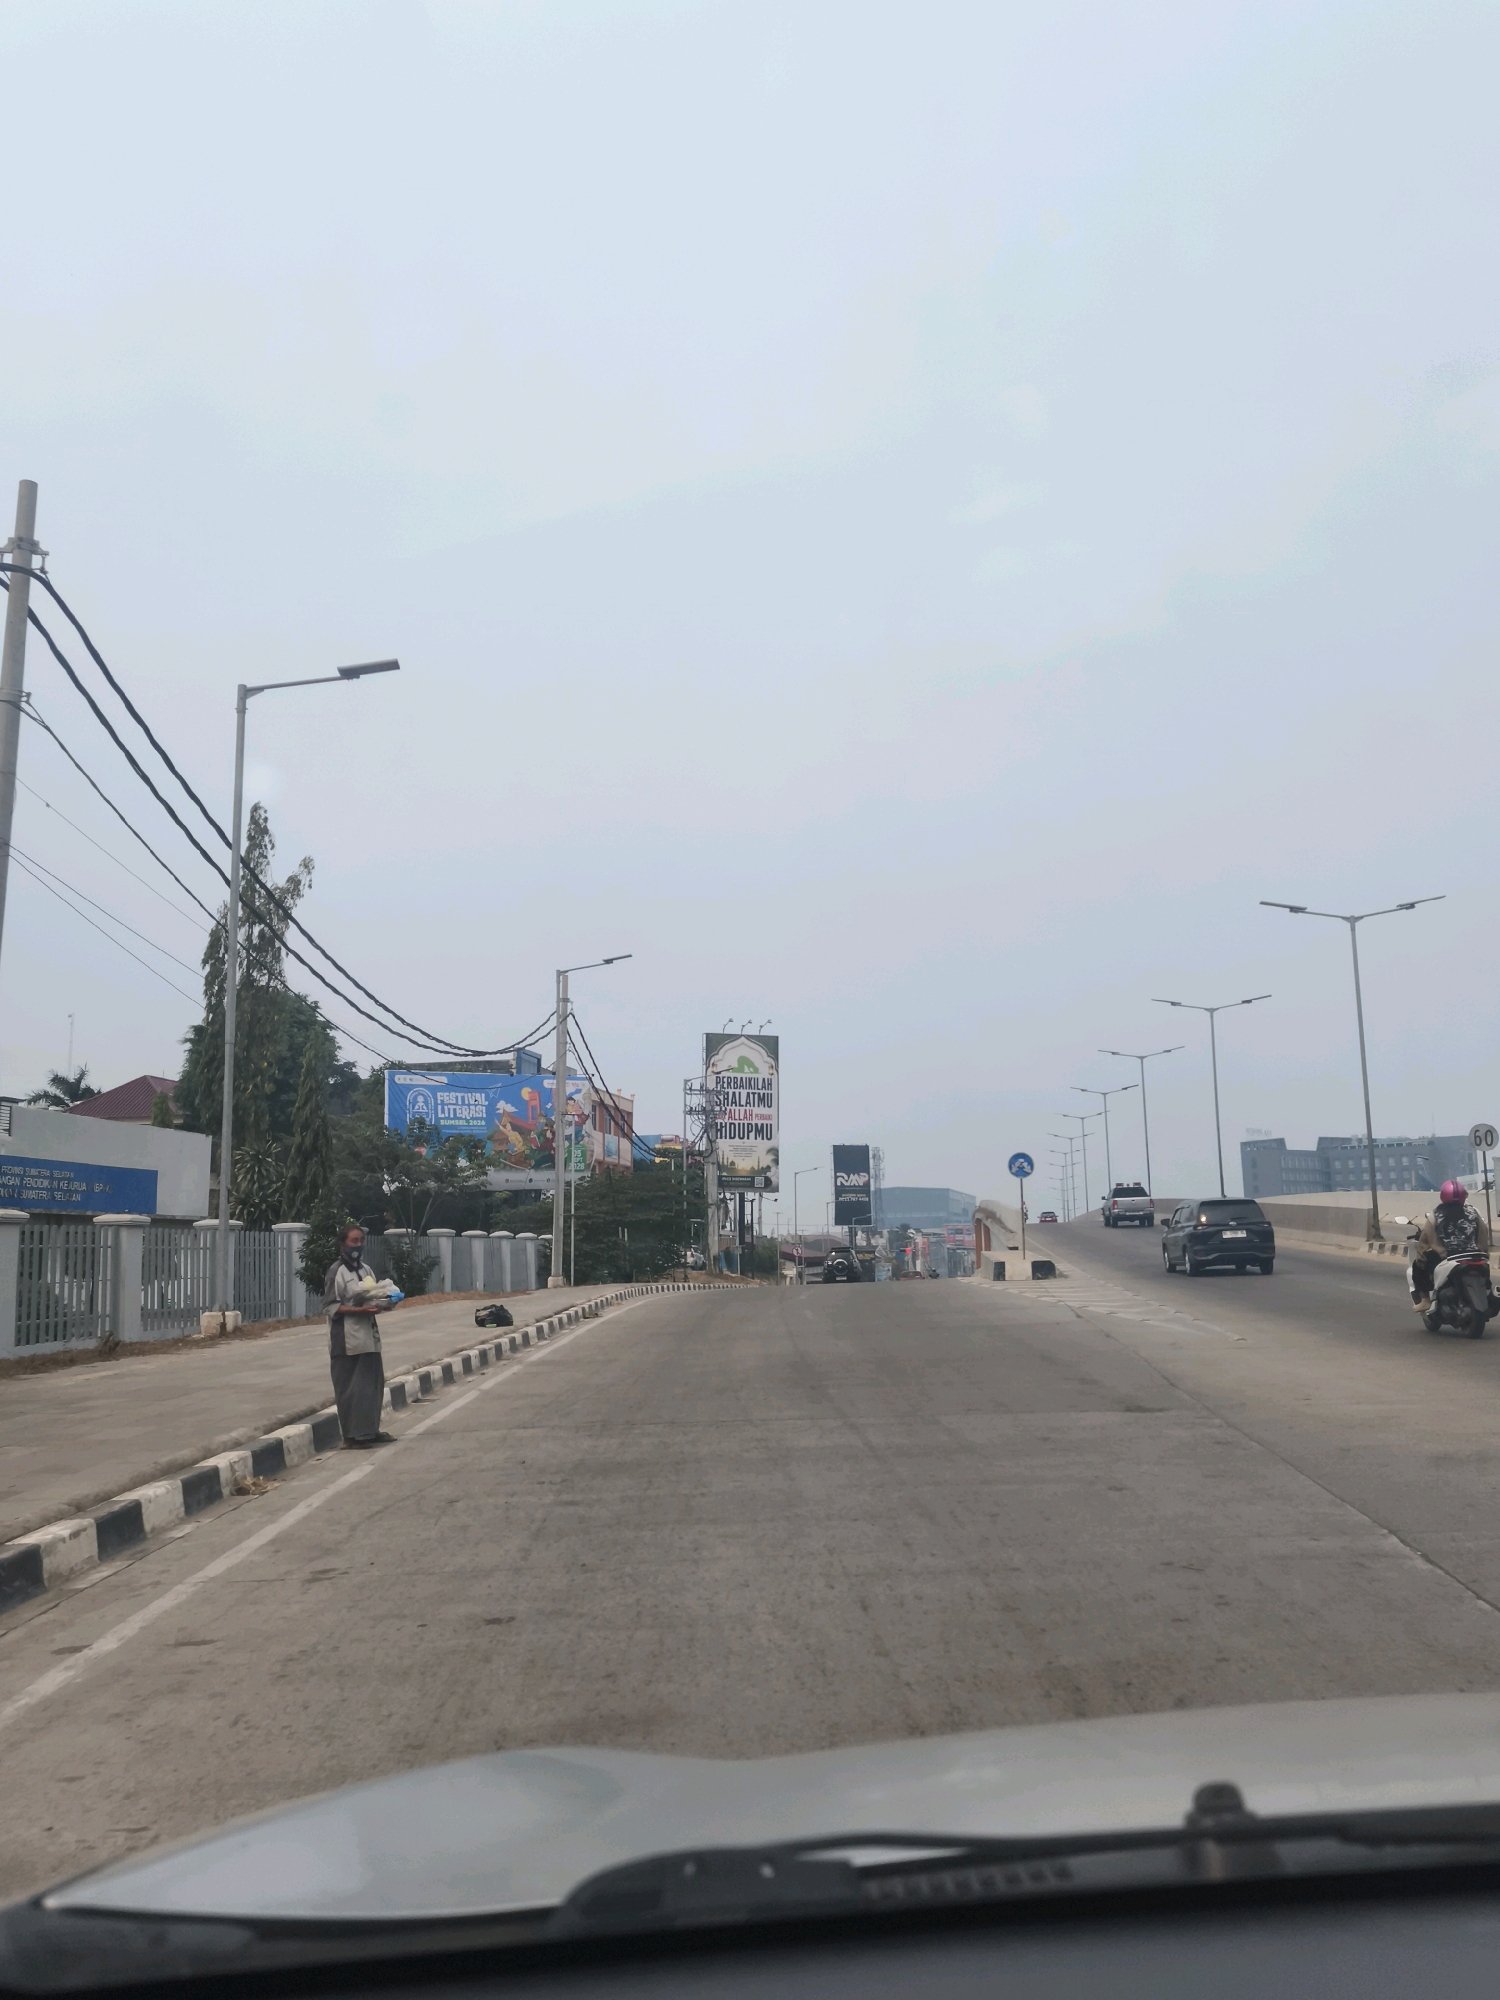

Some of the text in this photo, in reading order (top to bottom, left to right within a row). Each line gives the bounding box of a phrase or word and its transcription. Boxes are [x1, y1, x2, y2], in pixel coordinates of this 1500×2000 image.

[715, 1076, 772, 1091] PERBAIKILAH
[436, 1092, 488, 1106] FESTIVAL
[715, 1091, 772, 1108] SHALATMU
[437, 1104, 486, 1119] LITERASI
[727, 1108, 753, 1121] ALLAH
[715, 1121, 772, 1141] HIDUPMU
[1474, 1129, 1493, 1147] 60
[1, 1165, 75, 1178] PROVINSI SUMATERA SELATAN
[22, 1177, 58, 1189] PENDIDIKAN
[59, 1181, 89, 1191] KEJURUA
[20, 1190, 51, 1200] SUMATERA
[54, 1191, 81, 1202] SELAAN
